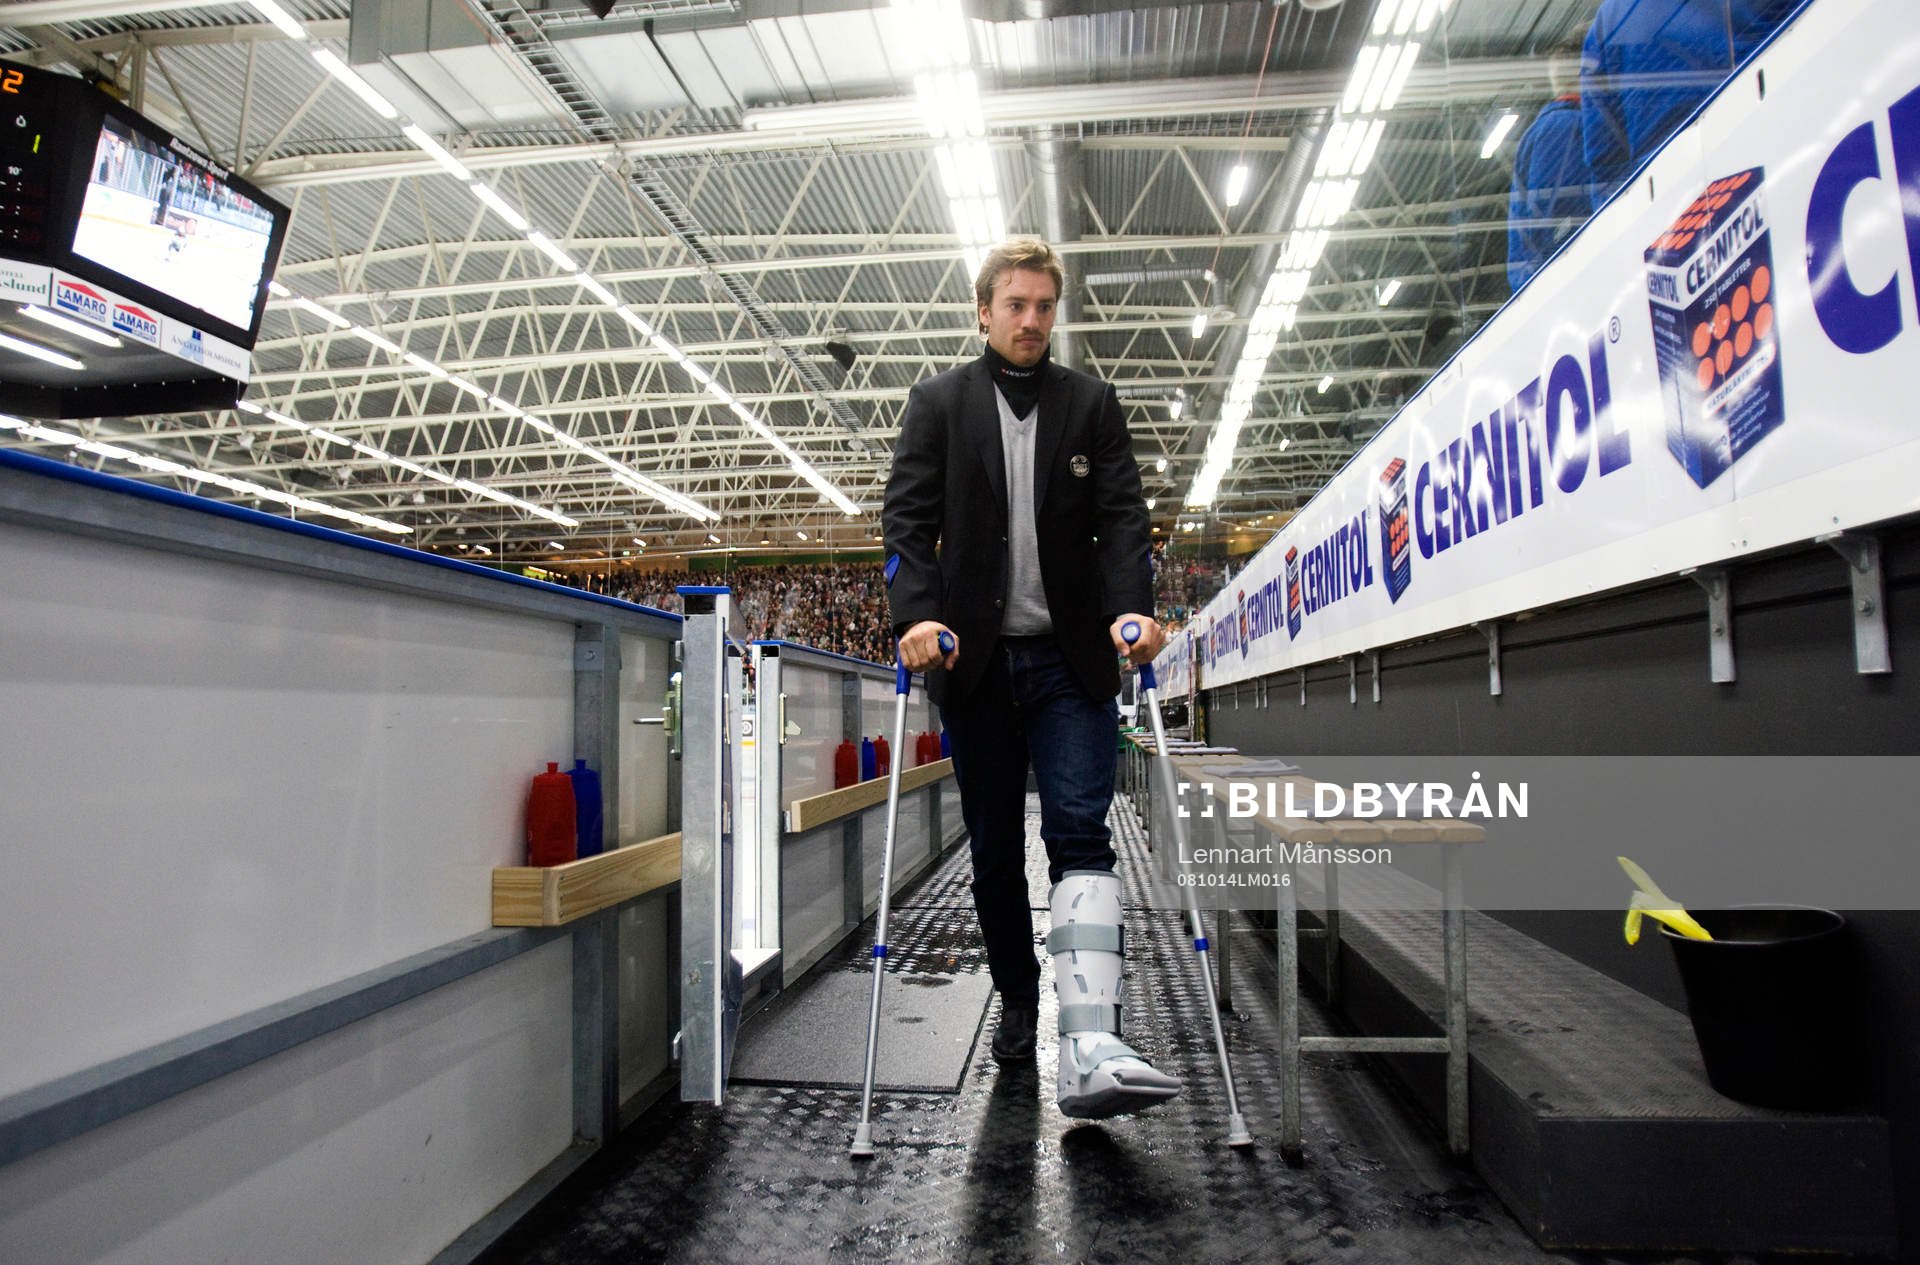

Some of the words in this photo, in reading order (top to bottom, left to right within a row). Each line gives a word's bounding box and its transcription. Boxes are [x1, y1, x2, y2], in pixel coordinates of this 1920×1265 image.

[0, 68, 24, 94] 2
[1686, 198, 1764, 295] CERNITOL
[1806, 84, 1920, 355] C
[57, 286, 107, 315] LAMARO
[113, 308, 157, 336] LAMARO
[1301, 509, 1373, 616] CERNITOL
[1247, 574, 1284, 642] CERNITOL
